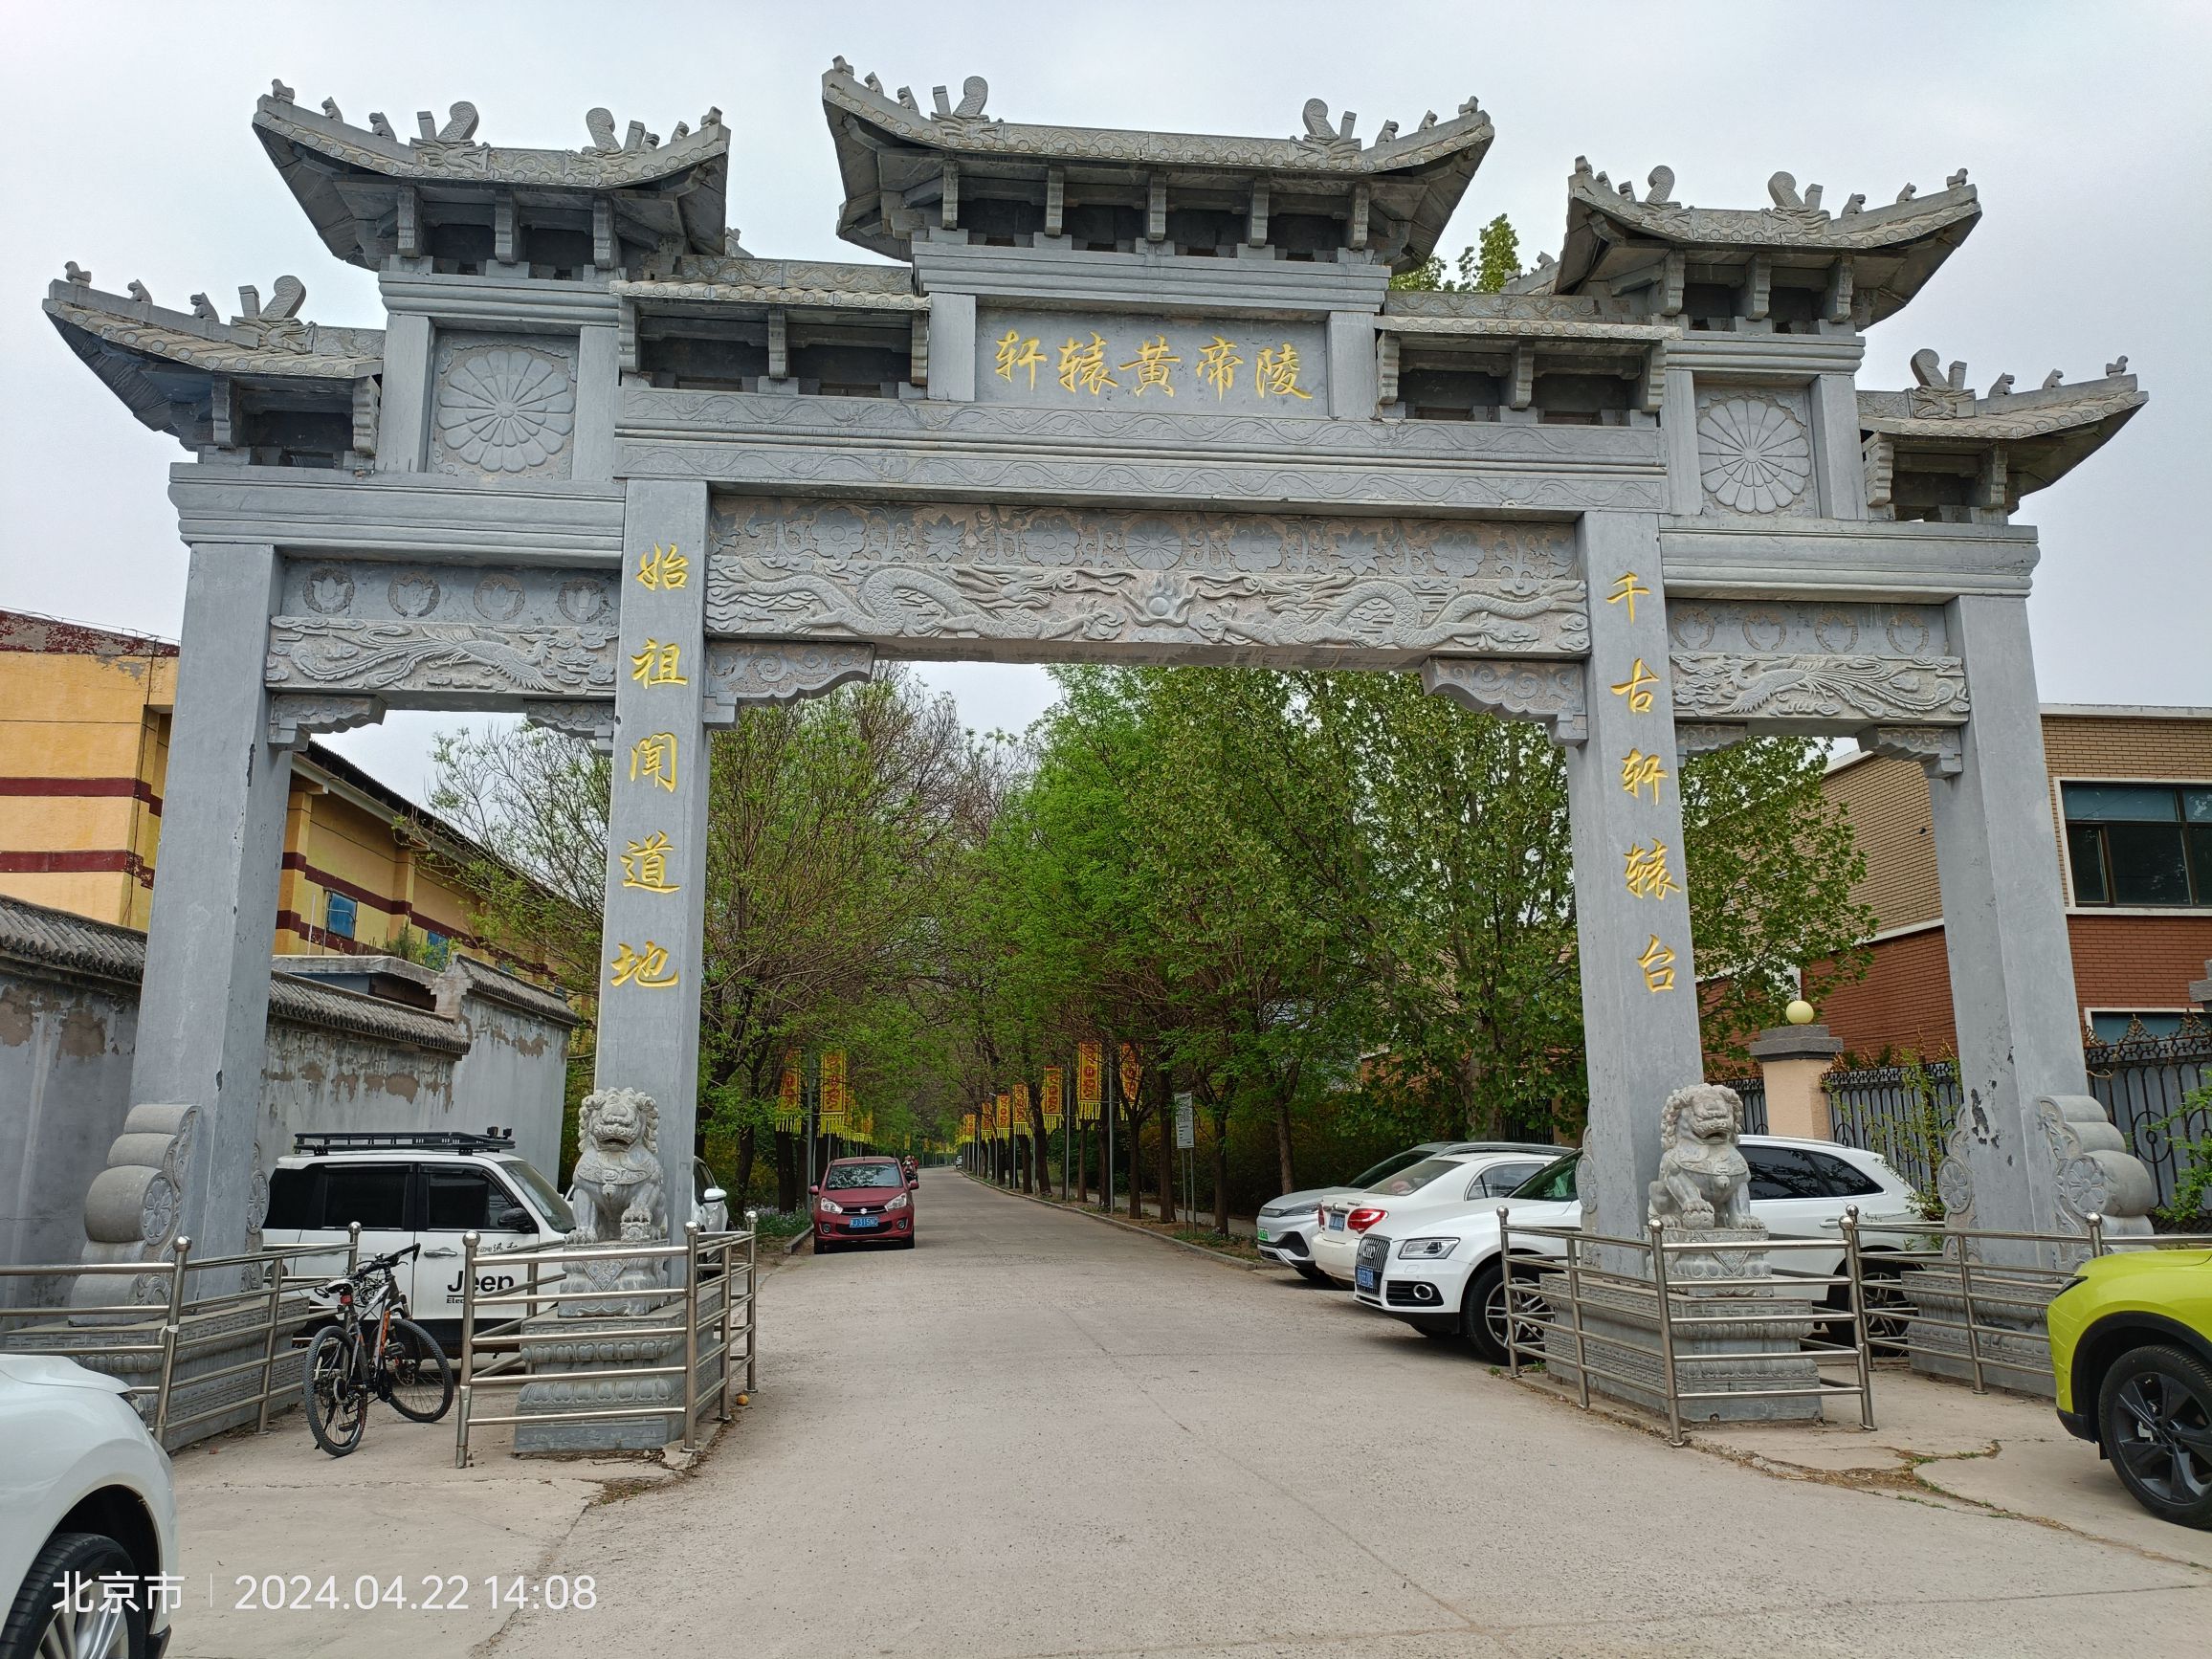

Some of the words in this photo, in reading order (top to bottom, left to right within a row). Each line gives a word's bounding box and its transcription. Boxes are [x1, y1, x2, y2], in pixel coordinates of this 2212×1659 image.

[995, 328, 1313, 403] 轩辕黄帝陵
[1606, 571, 1681, 993] 千古轩辕台
[447, 1270, 515, 1293] Jep
